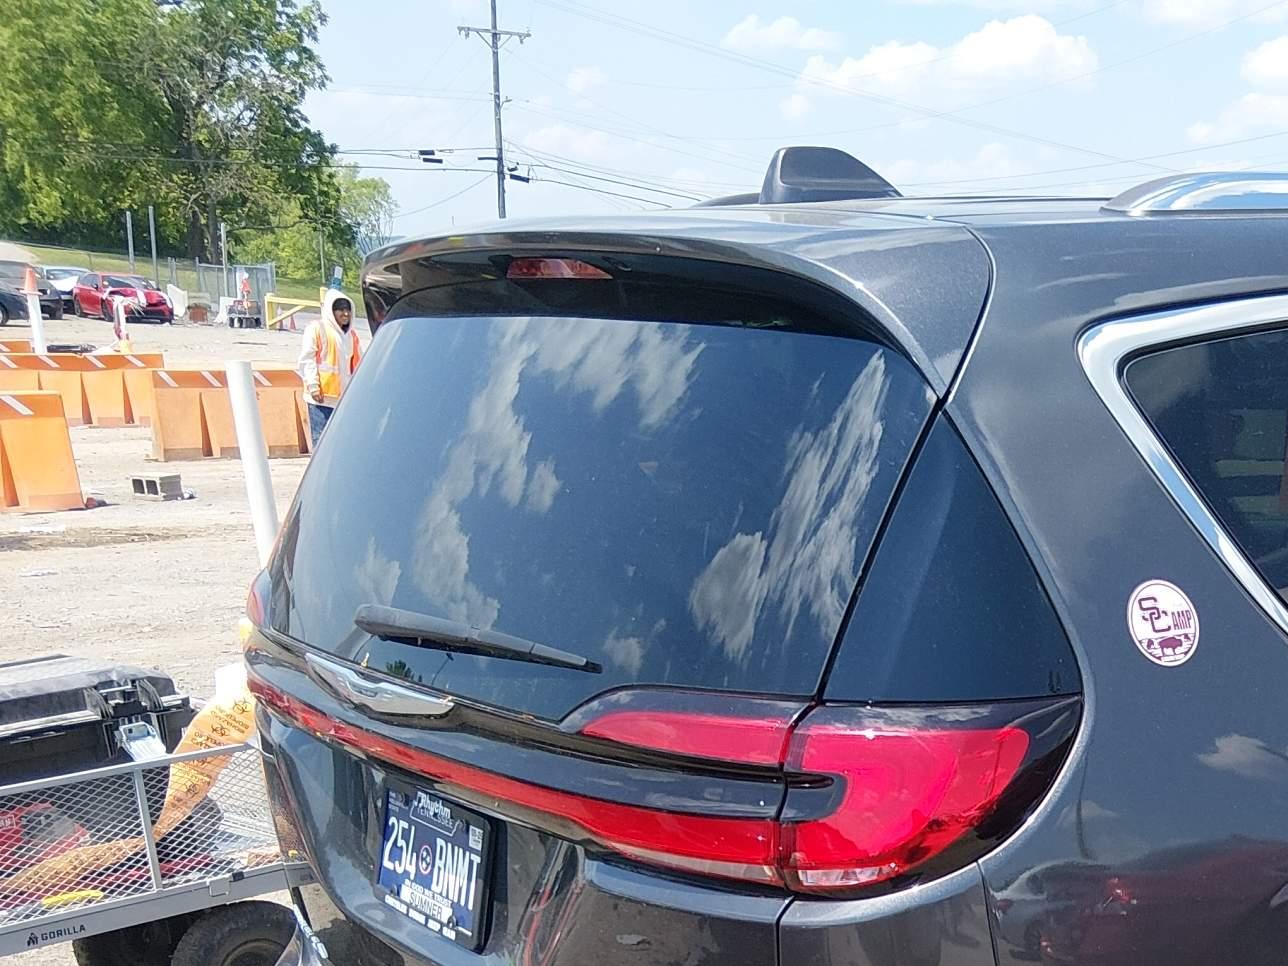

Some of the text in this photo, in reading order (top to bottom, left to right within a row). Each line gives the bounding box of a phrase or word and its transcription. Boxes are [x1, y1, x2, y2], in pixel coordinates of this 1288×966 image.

[383, 816, 481, 911] 254 BNMT
[409, 891, 443, 920] SUMNER
[41, 924, 86, 941] GORILLA
